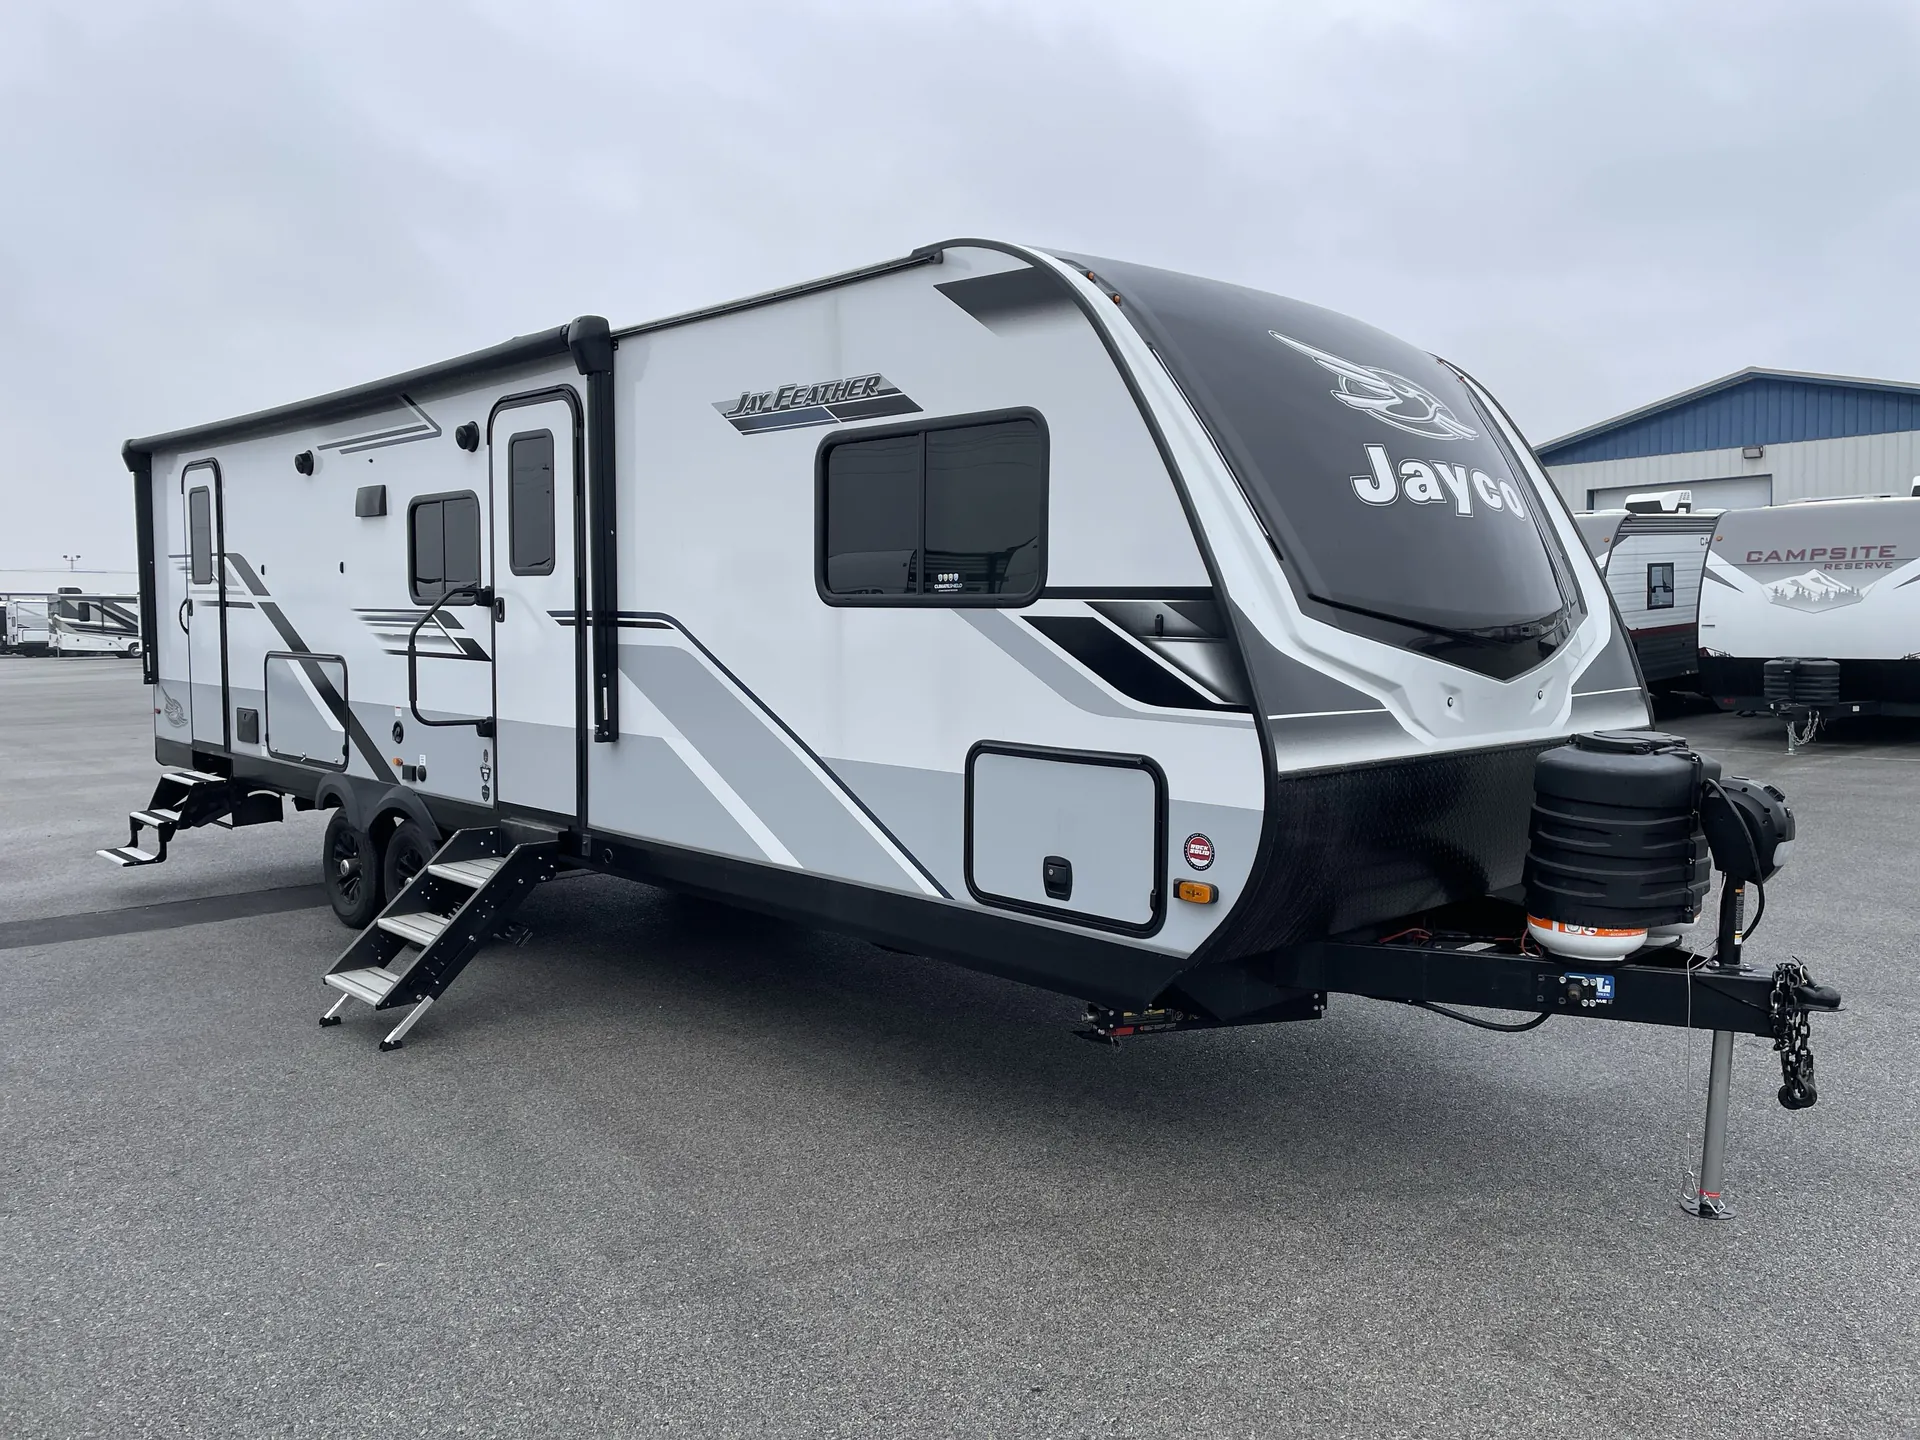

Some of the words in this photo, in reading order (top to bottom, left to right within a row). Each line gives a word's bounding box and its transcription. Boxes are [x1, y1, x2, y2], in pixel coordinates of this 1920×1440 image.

[726, 392, 772, 417] JAY
[771, 373, 882, 410] FEATHER
[1350, 444, 1526, 520] Jayco
[1746, 545, 1897, 563] CAMPSITE
[1824, 562, 1893, 571] RESERVE
